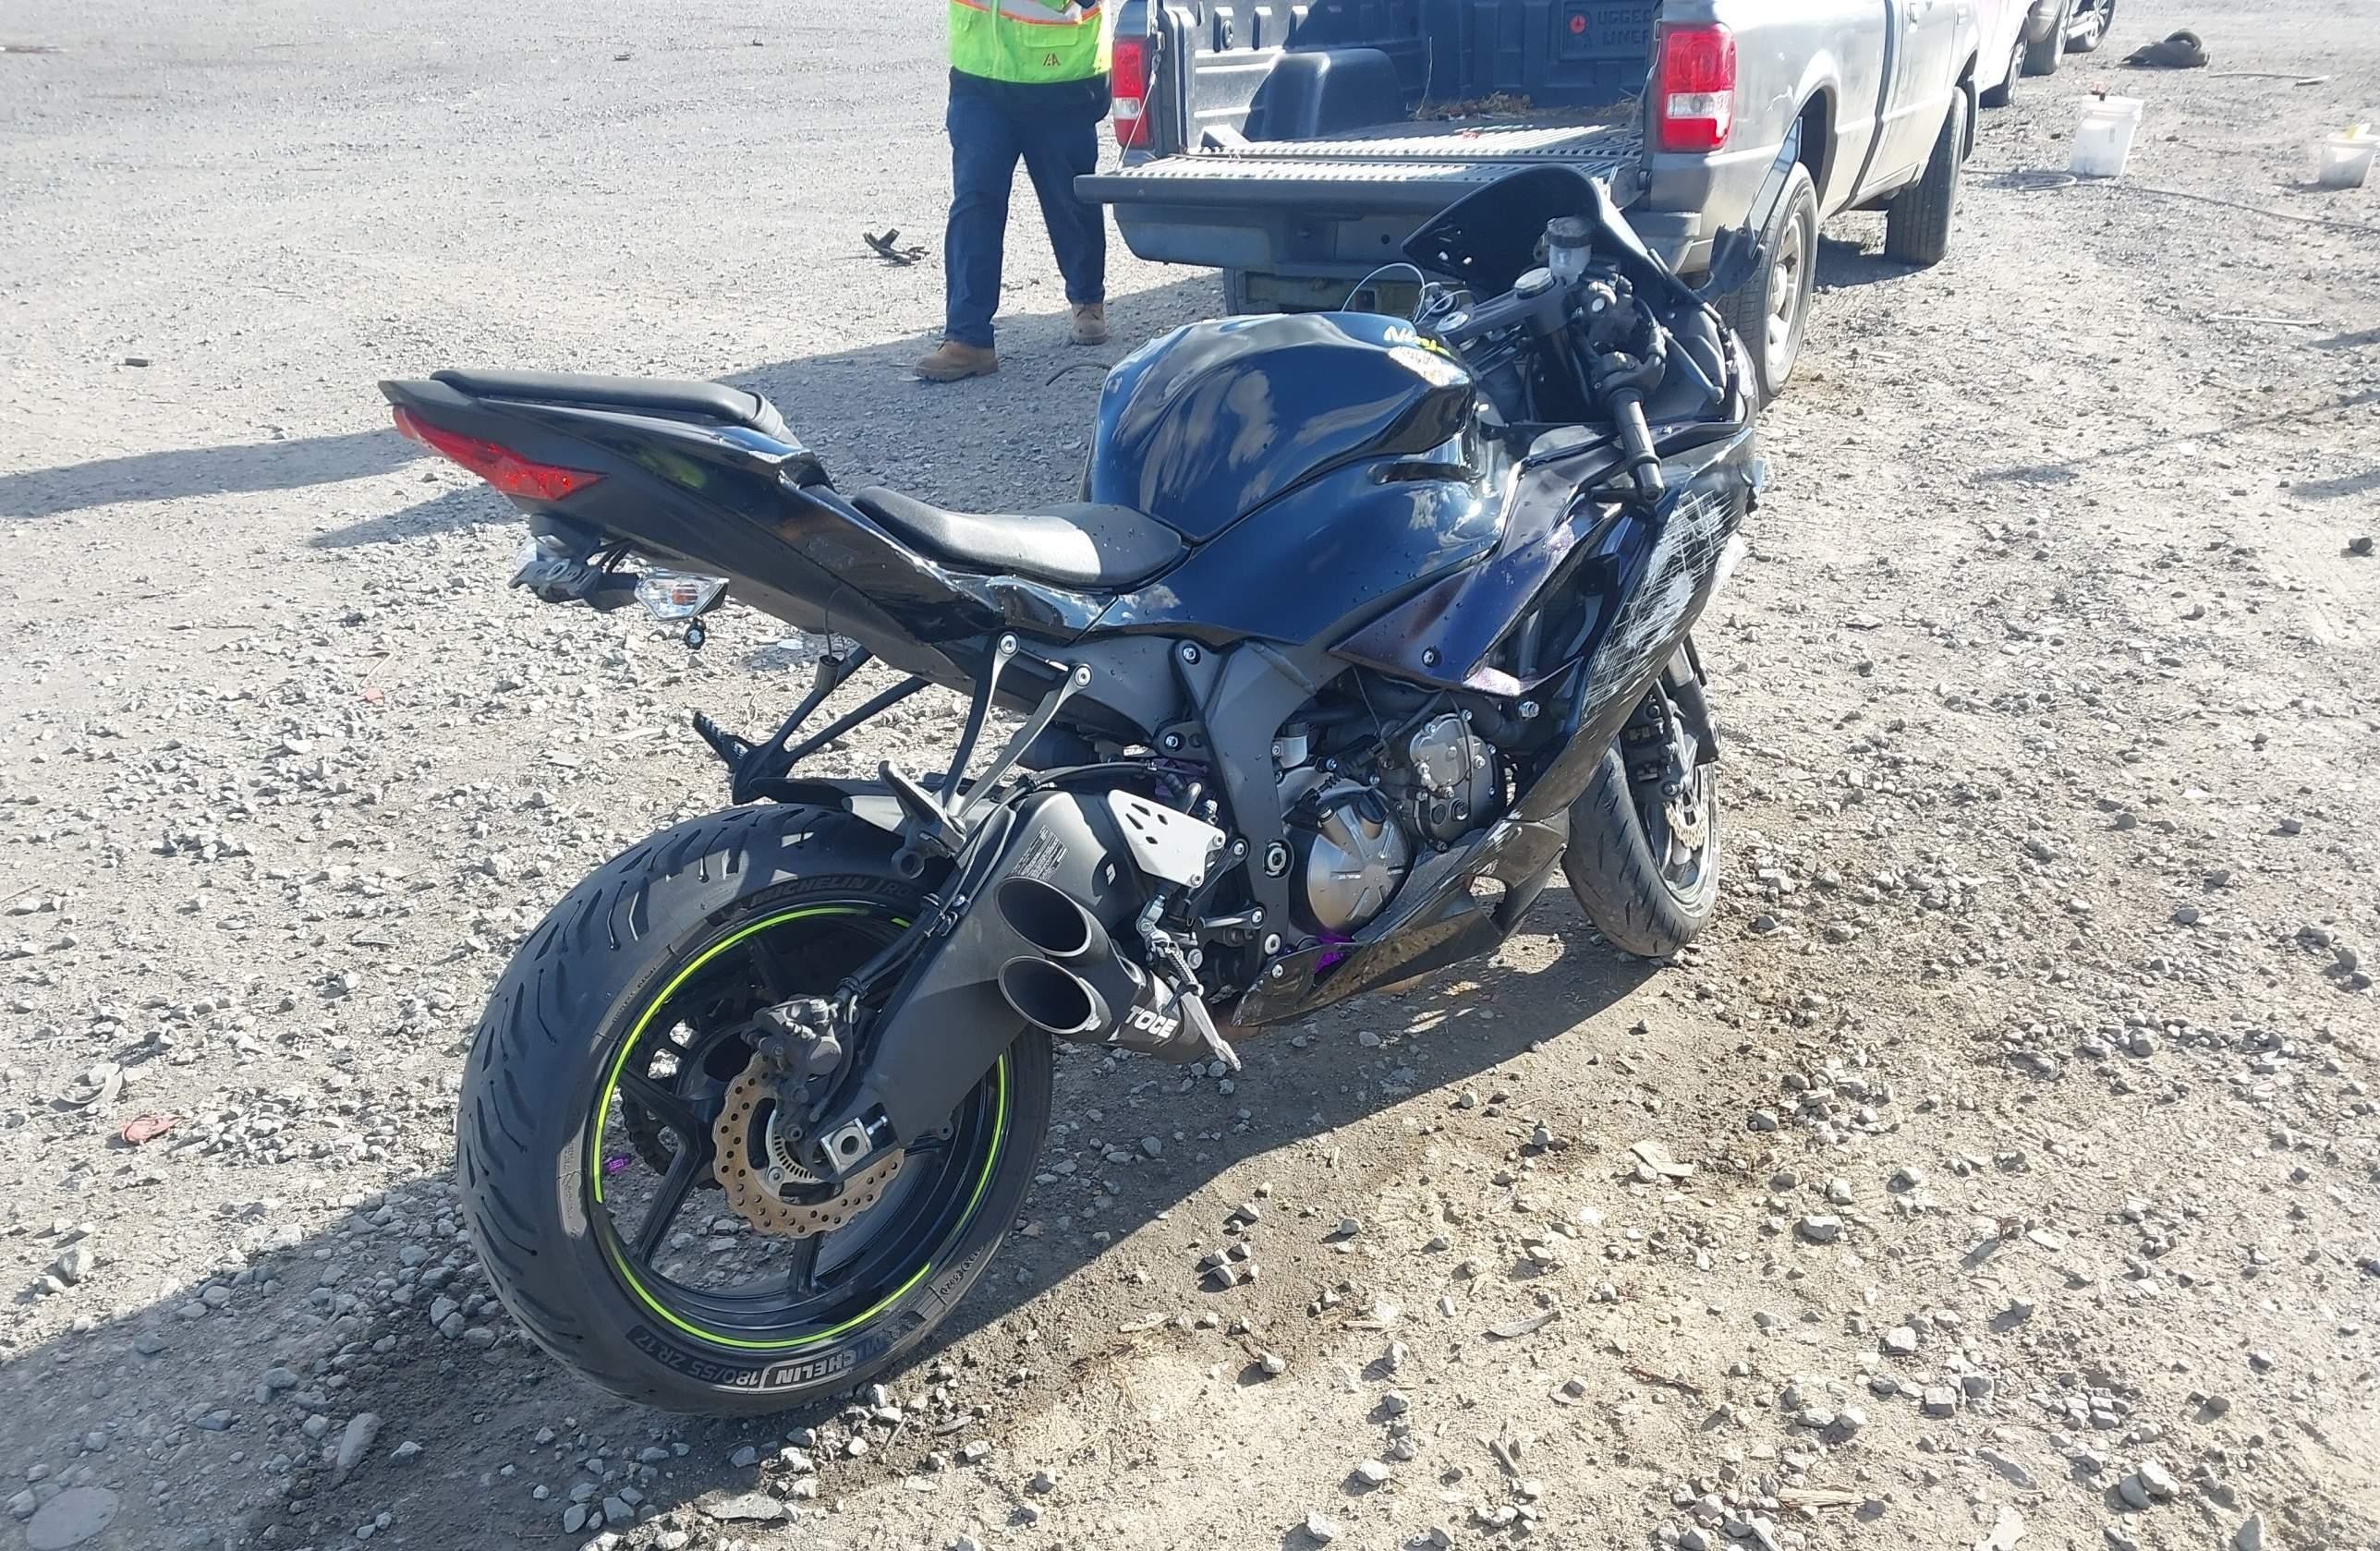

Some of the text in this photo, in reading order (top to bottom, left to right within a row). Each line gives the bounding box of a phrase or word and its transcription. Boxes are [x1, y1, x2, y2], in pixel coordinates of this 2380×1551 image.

[1124, 1004, 1179, 1039] TOCE
[634, 1335, 759, 1386] 180/55 ZR 17
[775, 1337, 882, 1385] MICHELIN
